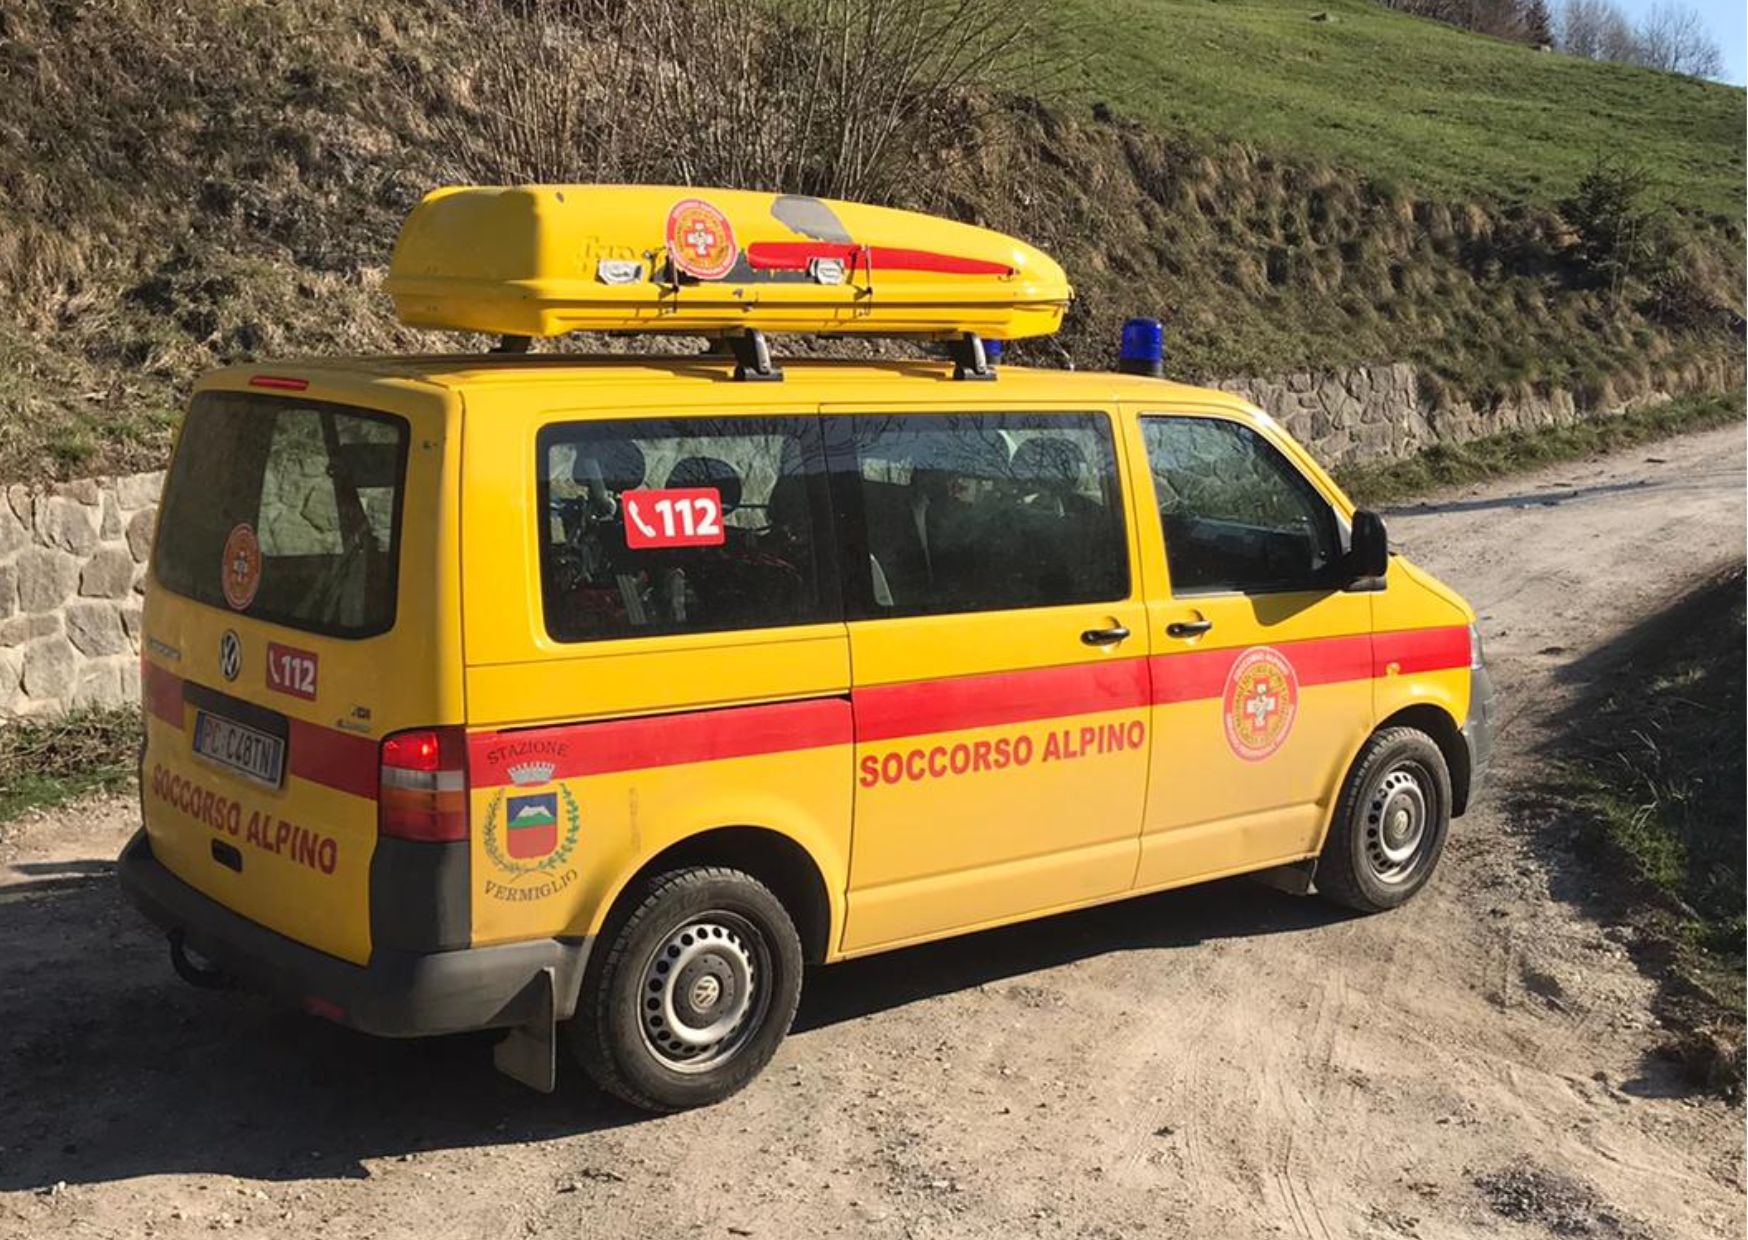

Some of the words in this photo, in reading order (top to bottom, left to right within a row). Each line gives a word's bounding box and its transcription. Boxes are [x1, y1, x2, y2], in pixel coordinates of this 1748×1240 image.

[655, 497, 720, 537] 112
[281, 655, 315, 693] 112
[487, 740, 569, 765] STAZIONE
[859, 735, 1033, 788] SOCCORSO
[1042, 720, 1146, 763] ALPINO
[152, 763, 242, 836] SOCCORSO
[246, 811, 338, 875] ALPINO
[484, 868, 578, 901] VERMIGLIO
